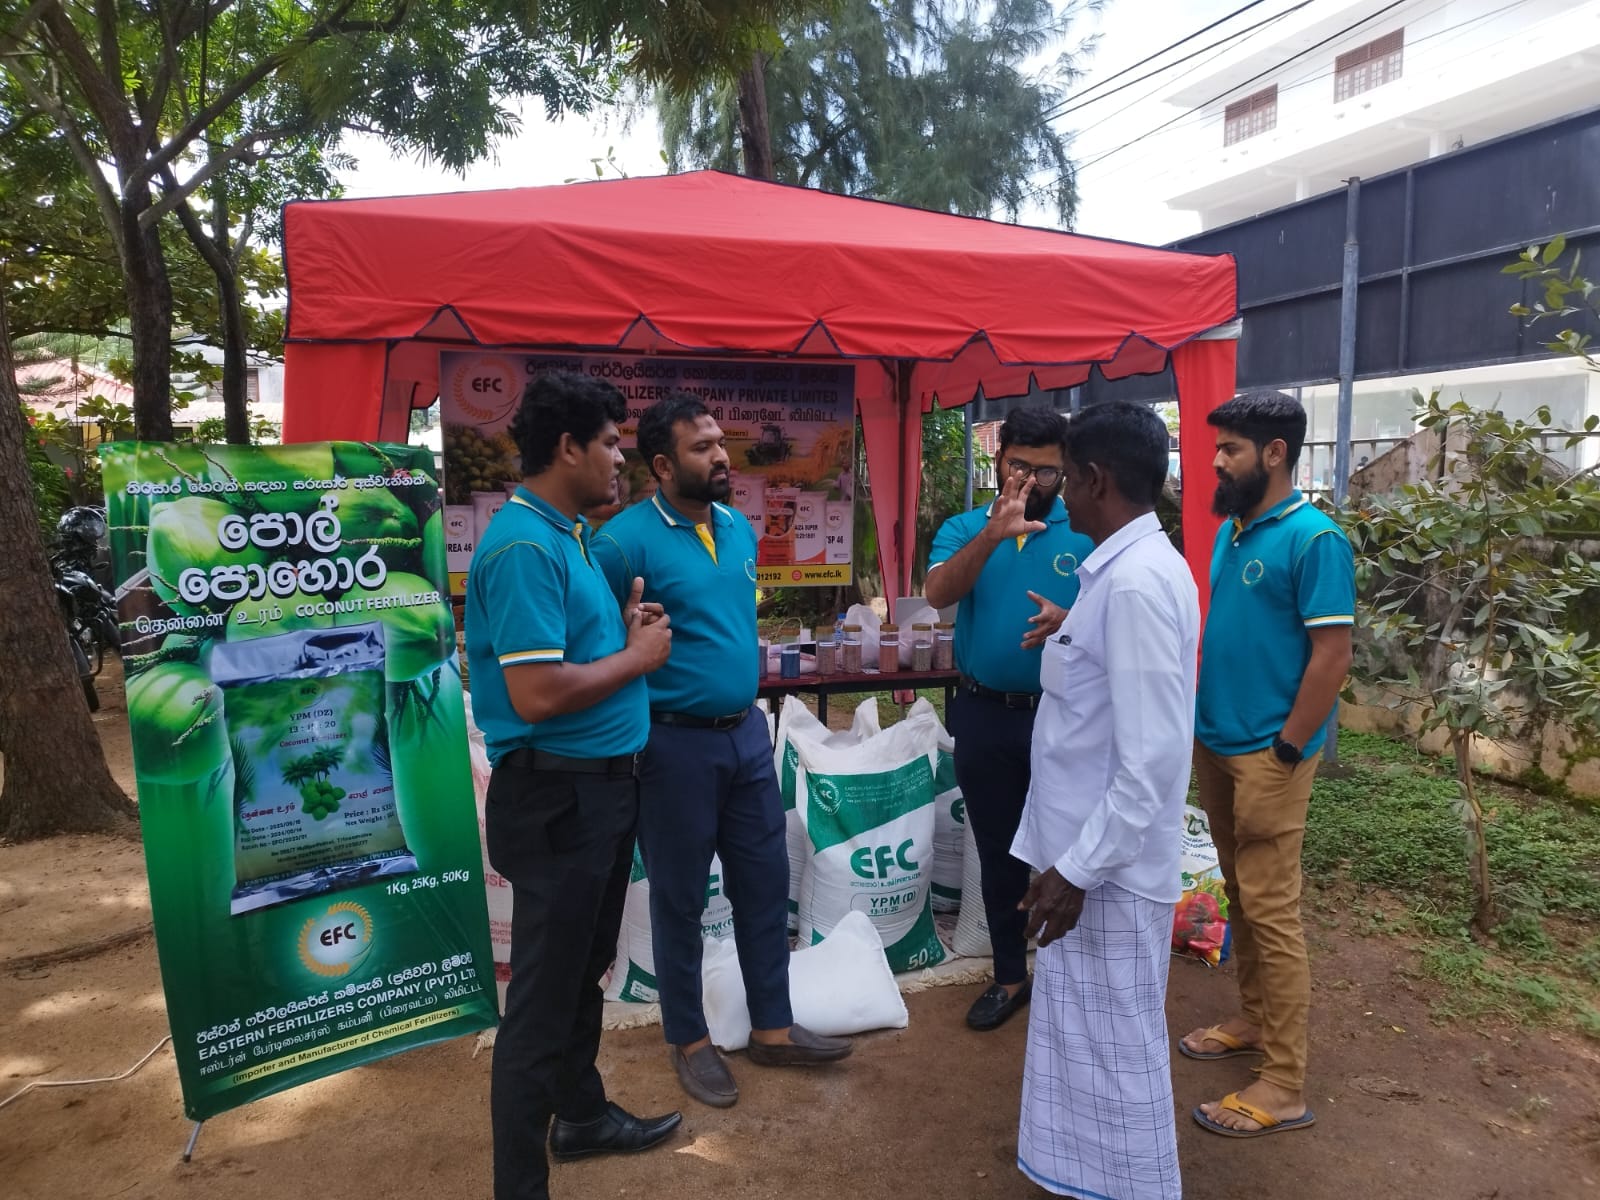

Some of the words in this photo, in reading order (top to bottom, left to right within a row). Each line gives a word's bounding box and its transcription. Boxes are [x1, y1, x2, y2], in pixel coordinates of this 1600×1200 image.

[471, 377, 503, 393] EFC
[617, 385, 671, 400] ILIZERS
[738, 388, 788, 403] PRIVATE
[791, 389, 838, 403] LIMITED
[217, 495, 342, 553] පොල්
[463, 543, 473, 552] 46
[178, 545, 387, 603] පොහොර
[804, 570, 842, 579] www.efc.lk
[236, 603, 283, 625] உரம்
[295, 599, 364, 617] COCONUT
[366, 591, 441, 610] FERTILIZER
[289, 711, 311, 721] YPM
[324, 720, 336, 729] 20
[279, 738, 309, 748] Coconut
[344, 809, 364, 819] Price
[358, 815, 383, 825] Weight
[850, 838, 919, 879] EFC
[386, 881, 410, 895] 1Kg,
[411, 876, 439, 890] 25Kg,
[441, 869, 470, 883] 50Kg
[870, 895, 900, 908] YPM
[319, 922, 357, 946] EFC
[906, 948, 929, 970] 50
[198, 1028, 265, 1061] EASTERN
[268, 1002, 355, 1036] FERTILIZERS
[357, 982, 421, 1008] COMPANY
[424, 973, 458, 993] (PVT)
[232, 1062, 277, 1084] (Importer
[278, 1057, 297, 1069] and
[298, 1038, 358, 1062] Manufacturer
[360, 1034, 370, 1043] of
[371, 1022, 413, 1039] Chemical
[414, 1008, 460, 1027] Fertilizers)
